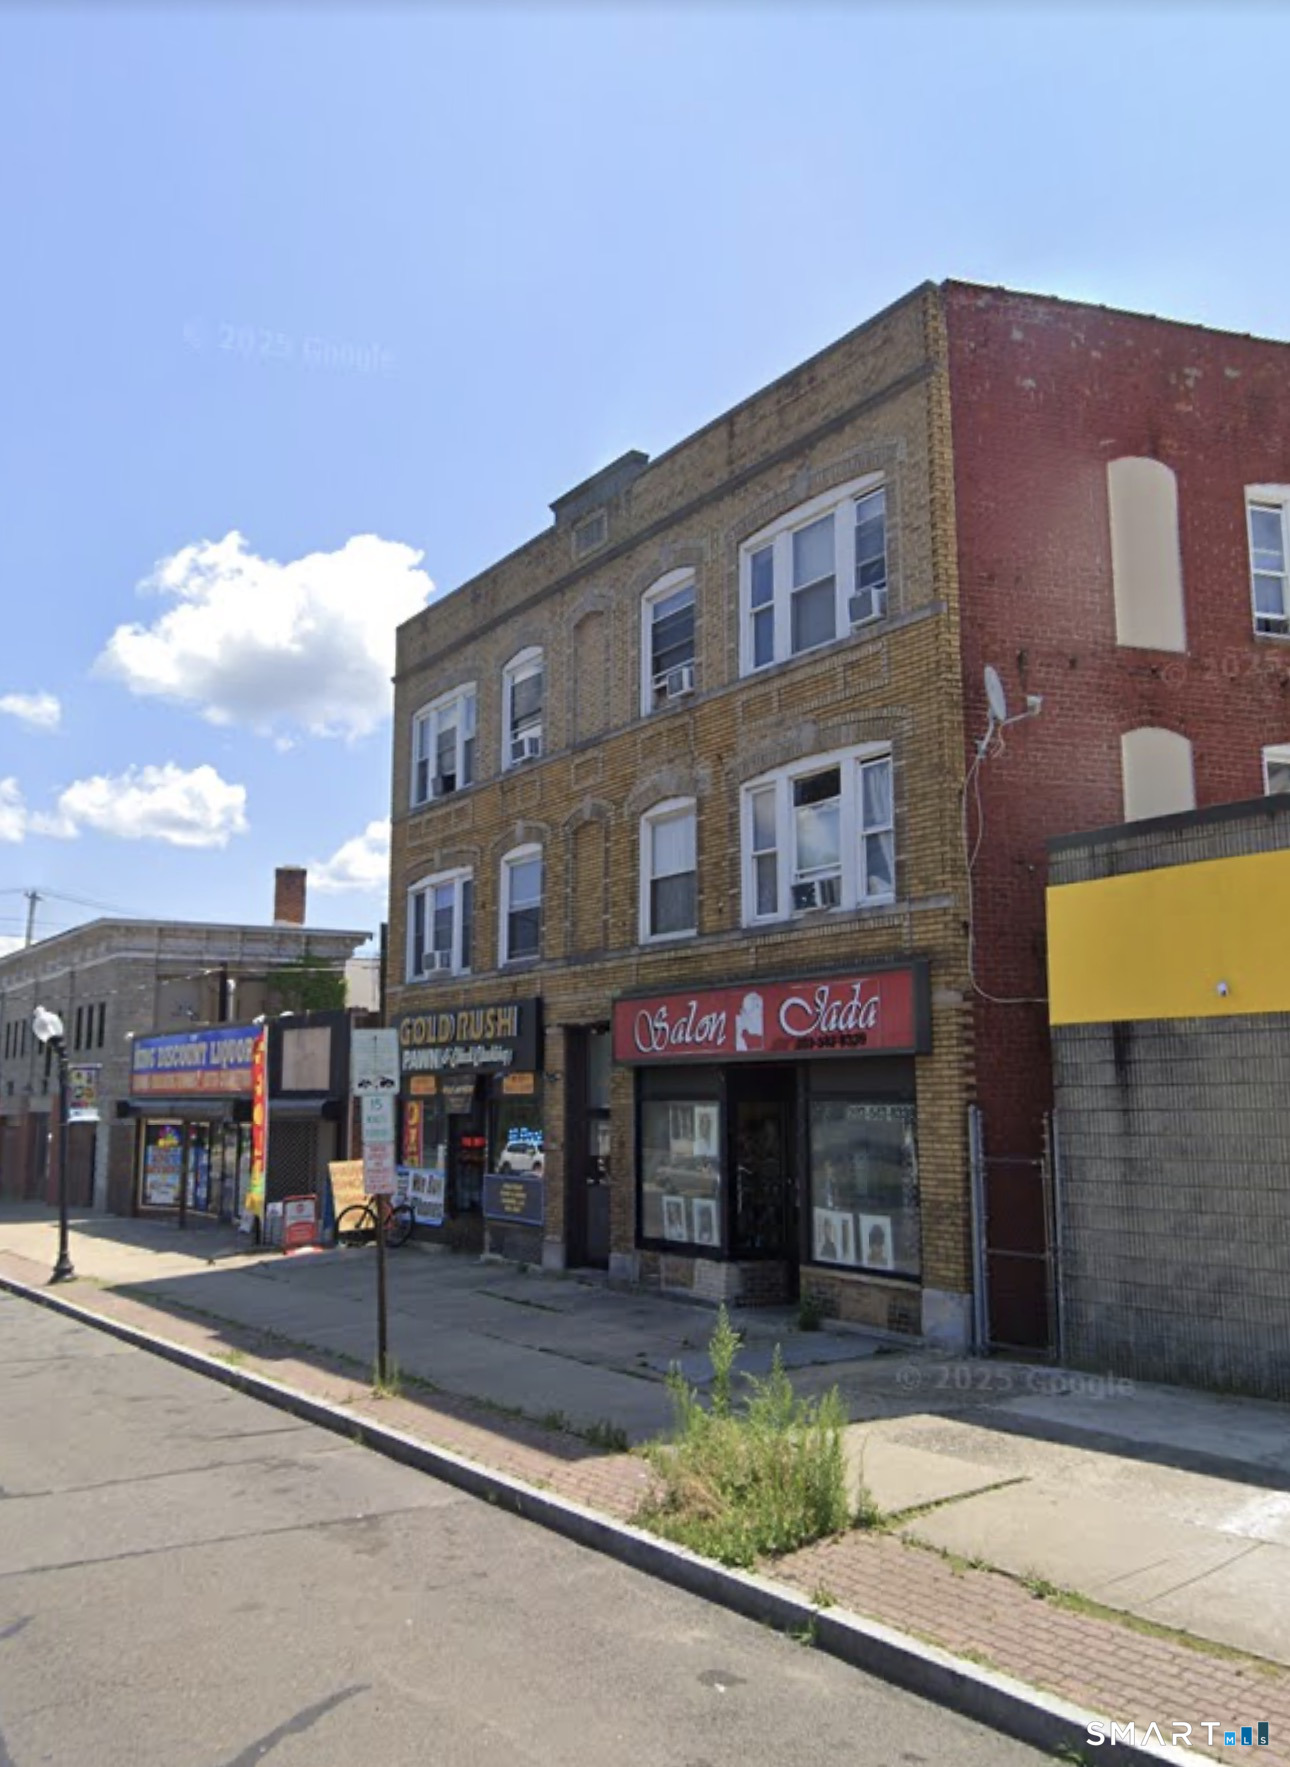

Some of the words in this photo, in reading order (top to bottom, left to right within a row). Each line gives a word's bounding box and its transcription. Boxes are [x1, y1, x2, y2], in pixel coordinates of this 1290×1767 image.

[400, 1014, 456, 1046] GOLD
[634, 1000, 727, 1053] Salon
[779, 982, 880, 1037] Jada
[157, 1041, 207, 1069] DISCOUNT
[402, 1047, 441, 1071] PAWN
